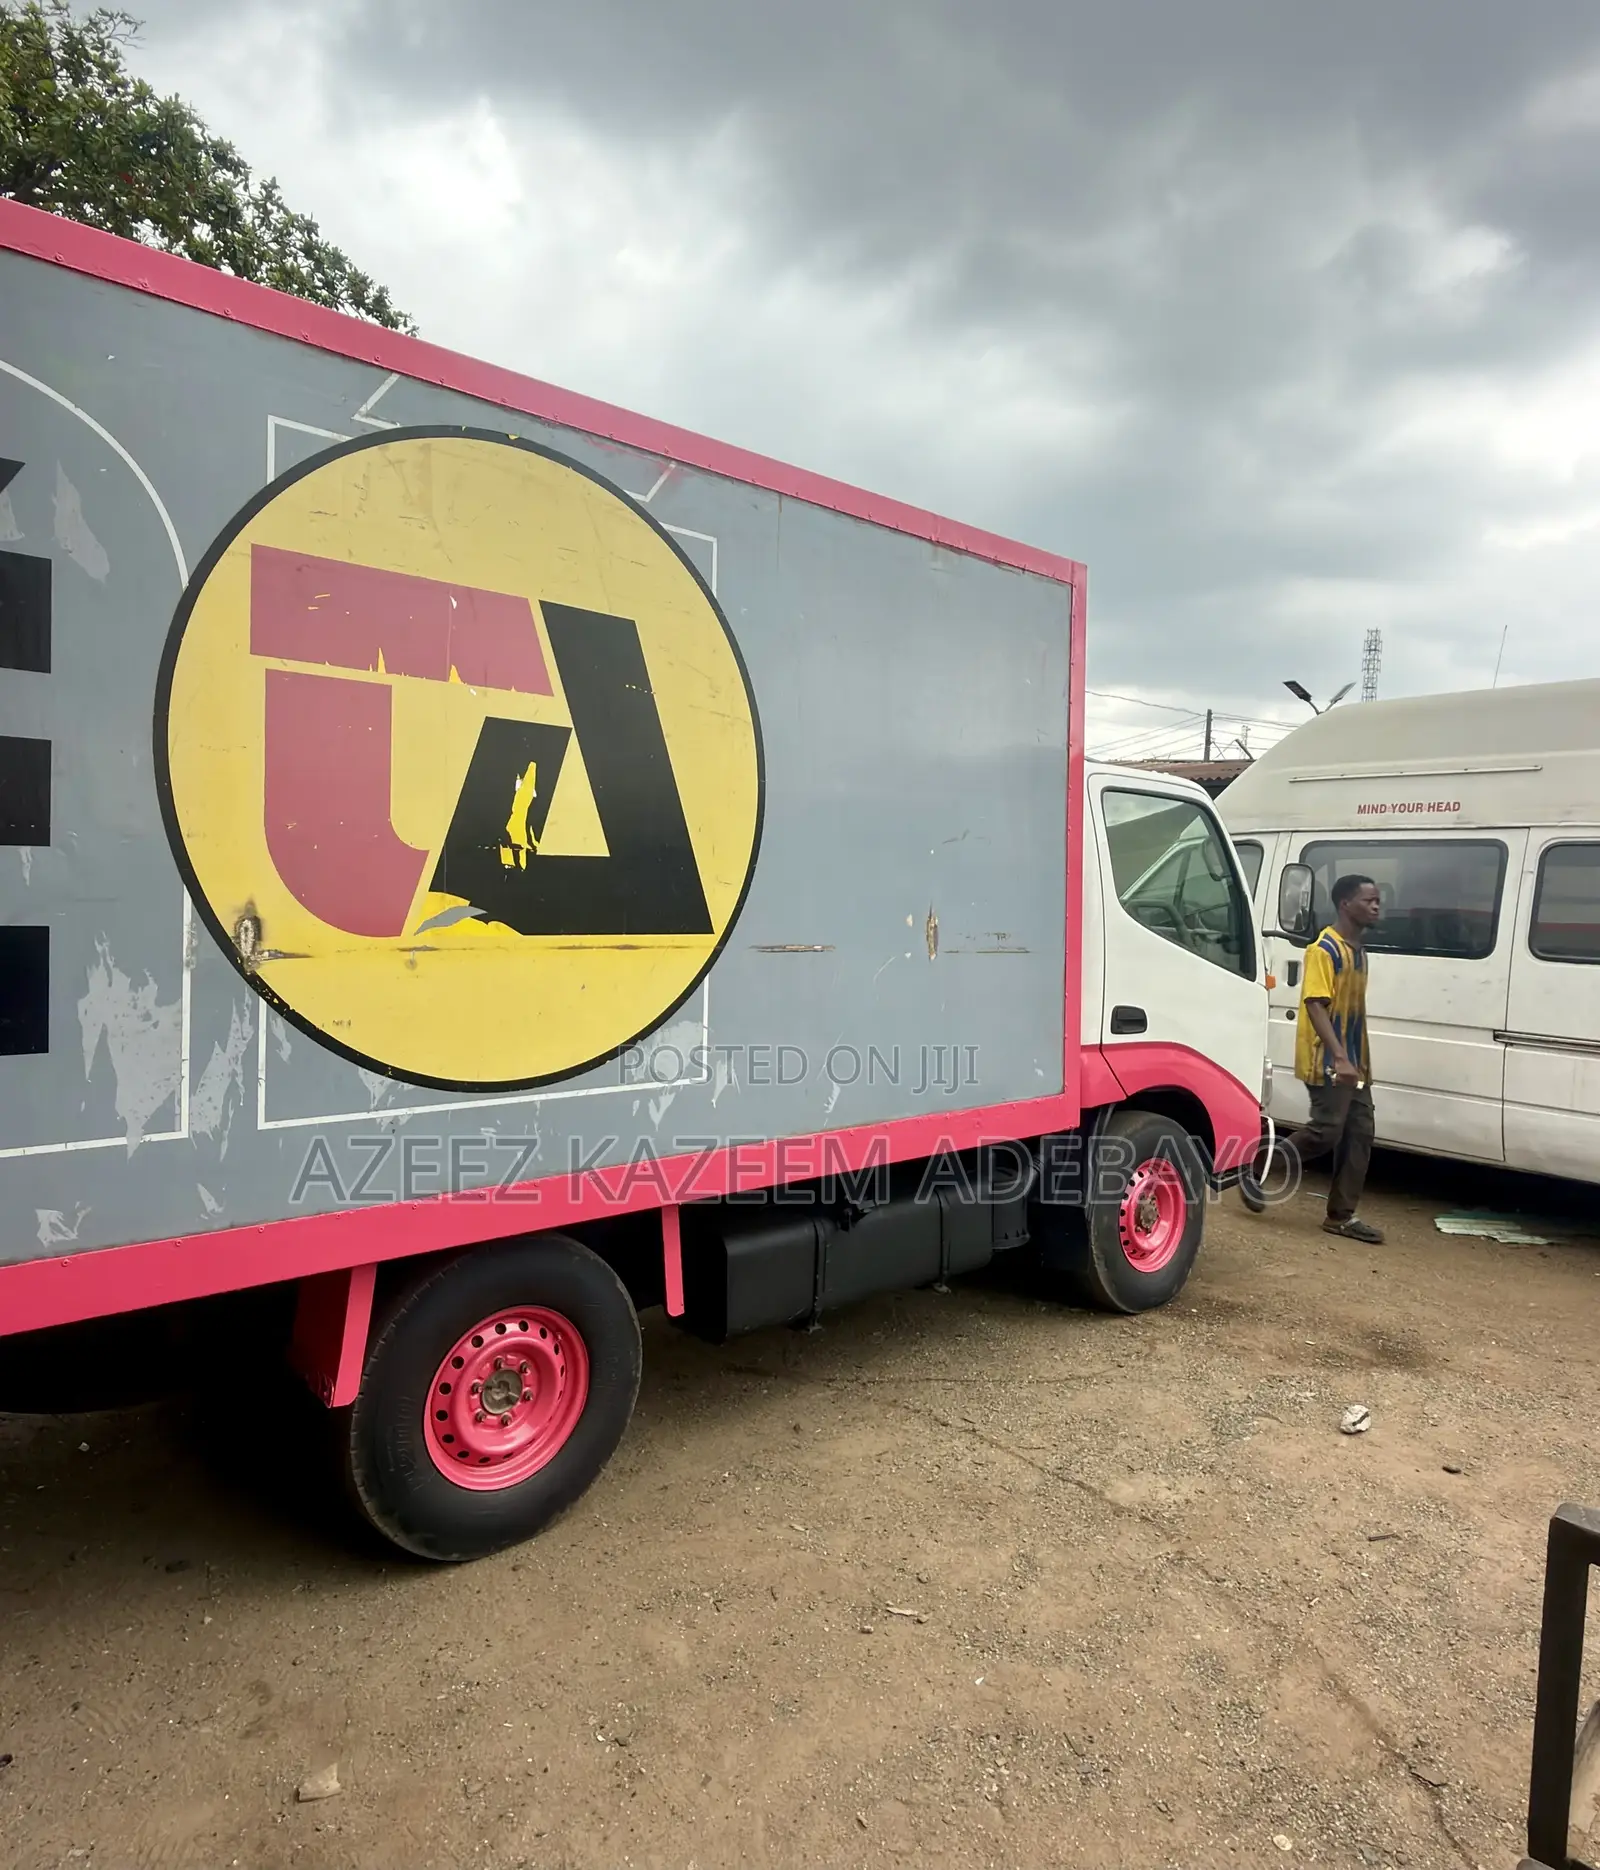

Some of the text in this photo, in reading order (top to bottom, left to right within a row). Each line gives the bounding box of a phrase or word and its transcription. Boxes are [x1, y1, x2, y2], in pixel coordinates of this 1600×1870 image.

[1357, 801, 1461, 815] MIND YOUR HEAD
